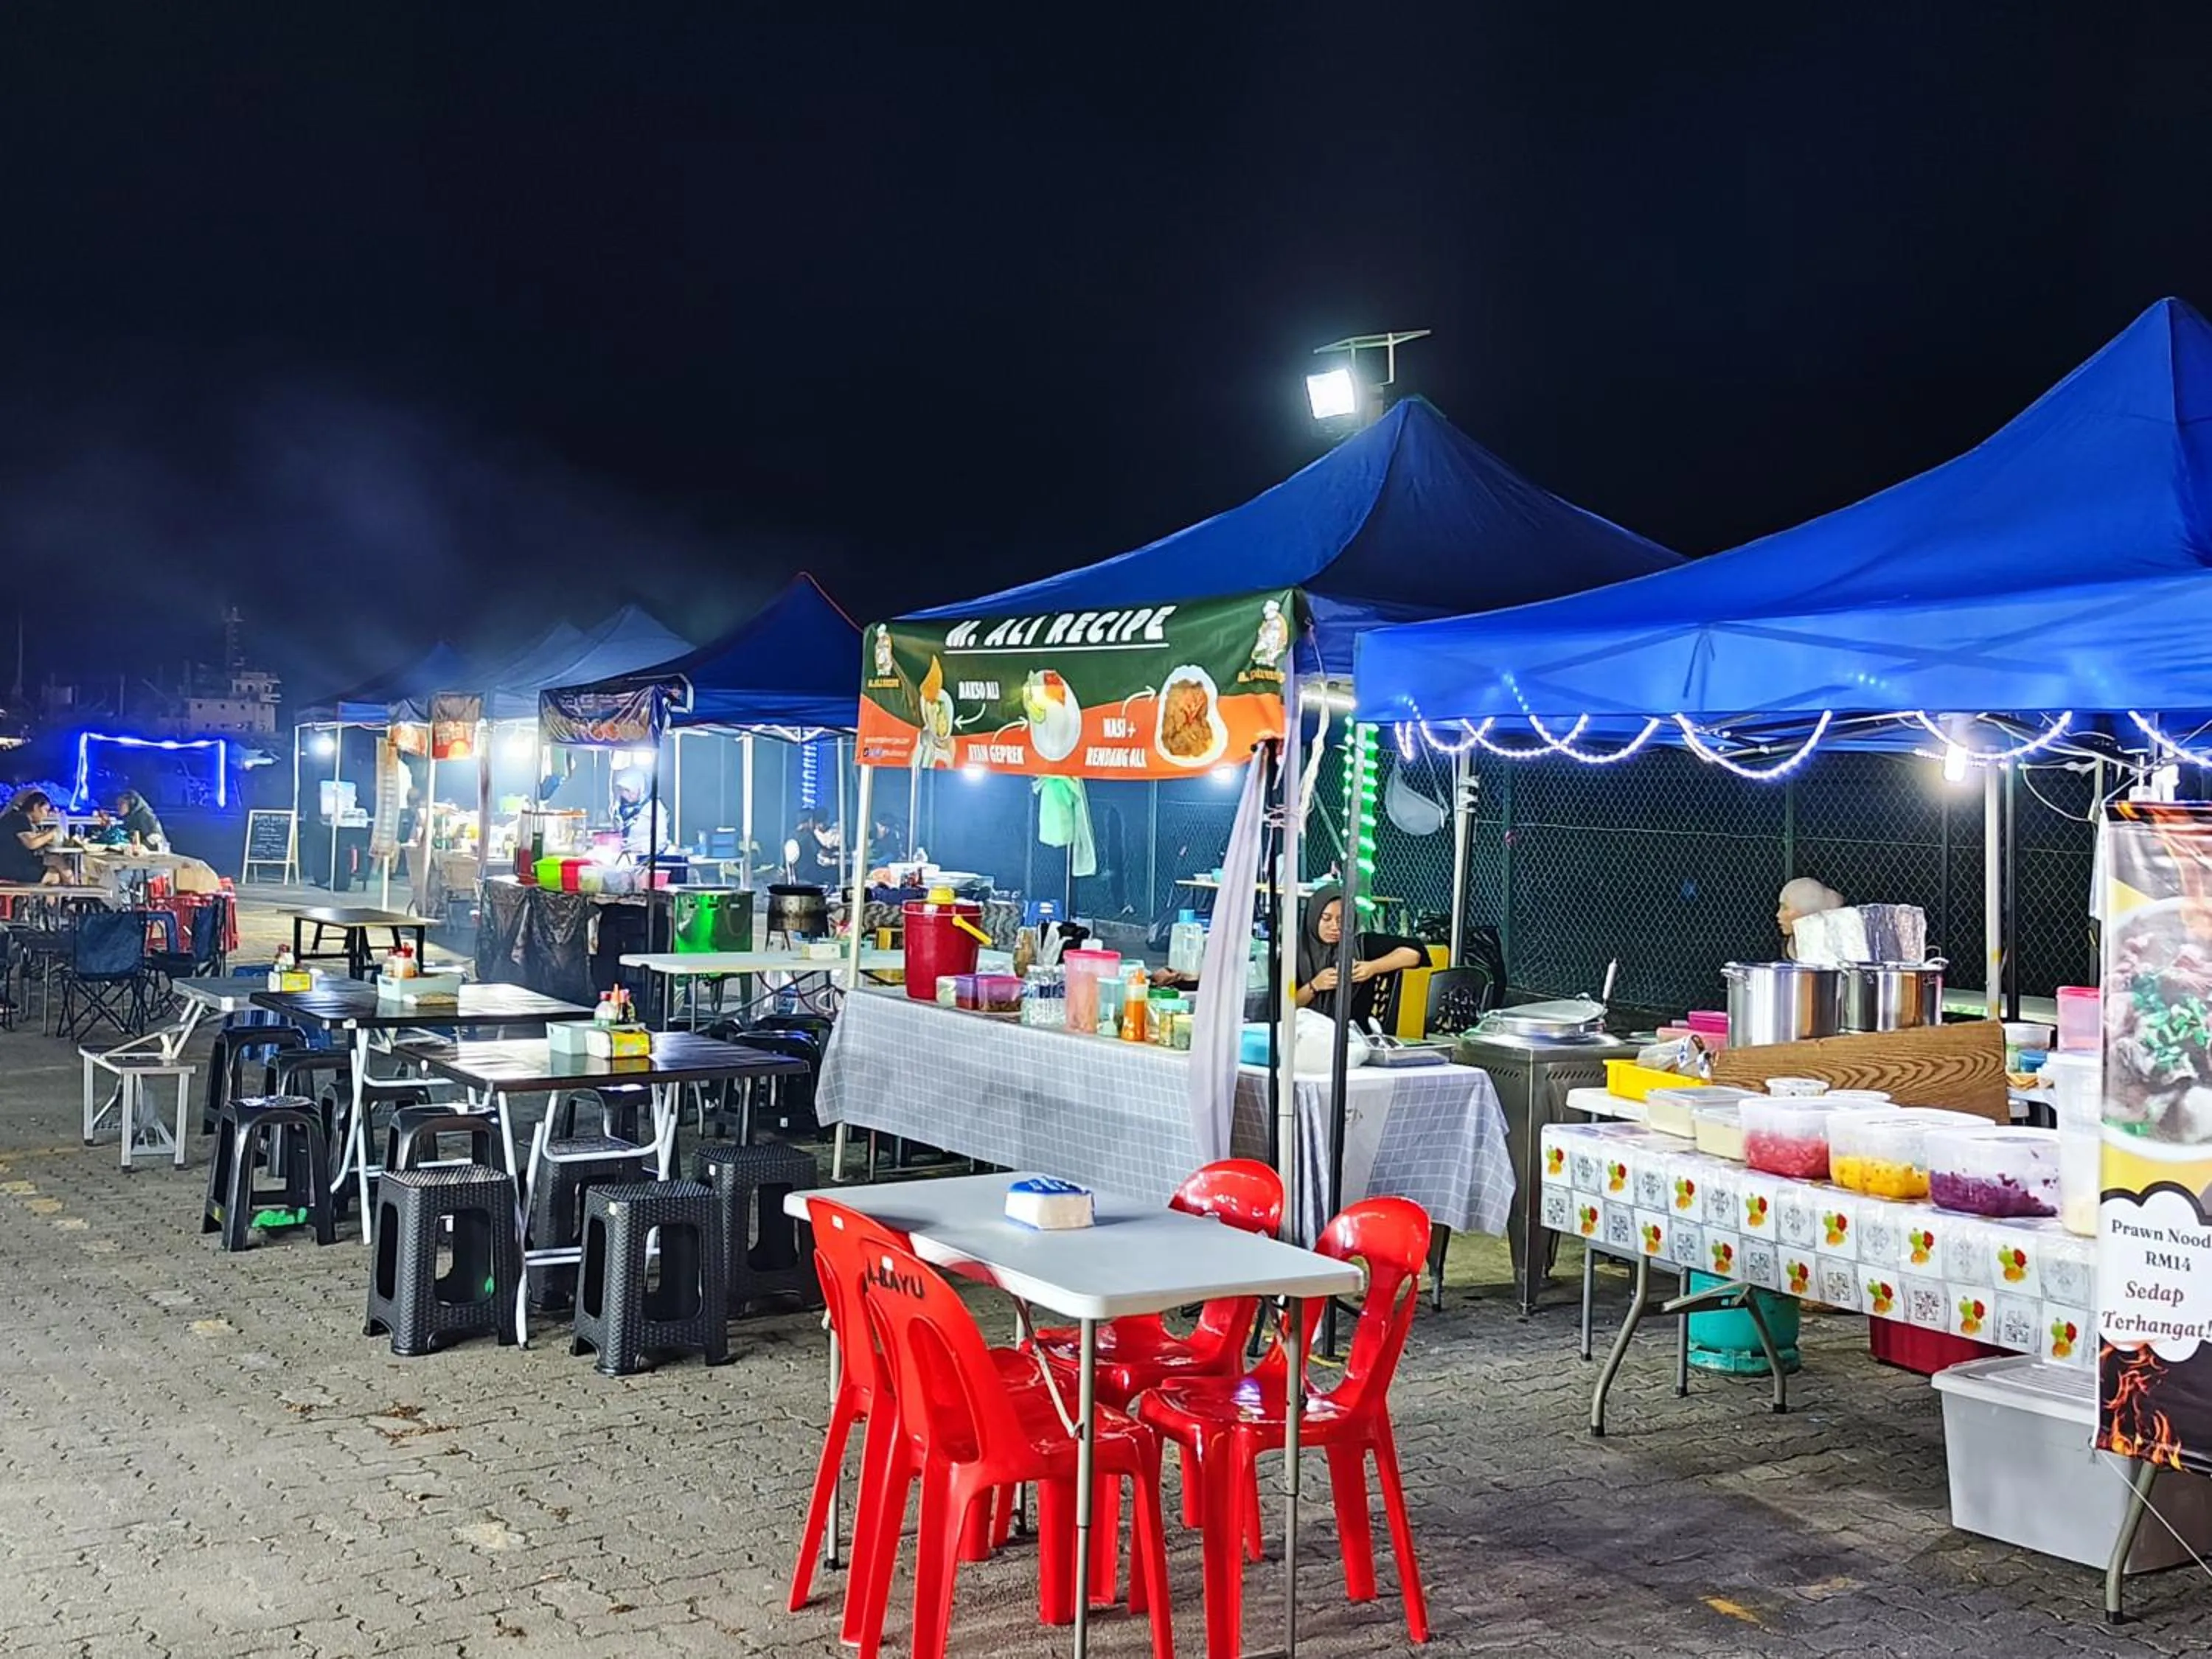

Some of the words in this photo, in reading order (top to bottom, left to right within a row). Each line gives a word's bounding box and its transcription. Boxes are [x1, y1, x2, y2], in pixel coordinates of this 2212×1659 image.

[984, 615, 1048, 647] ALI
[1043, 605, 1178, 644] RECIPE
[2111, 1218, 2164, 1242] Prawn
[2167, 1227, 2212, 1249] Nood
[2145, 1251, 2192, 1272] RM14
[2124, 1280, 2185, 1308] Sedap
